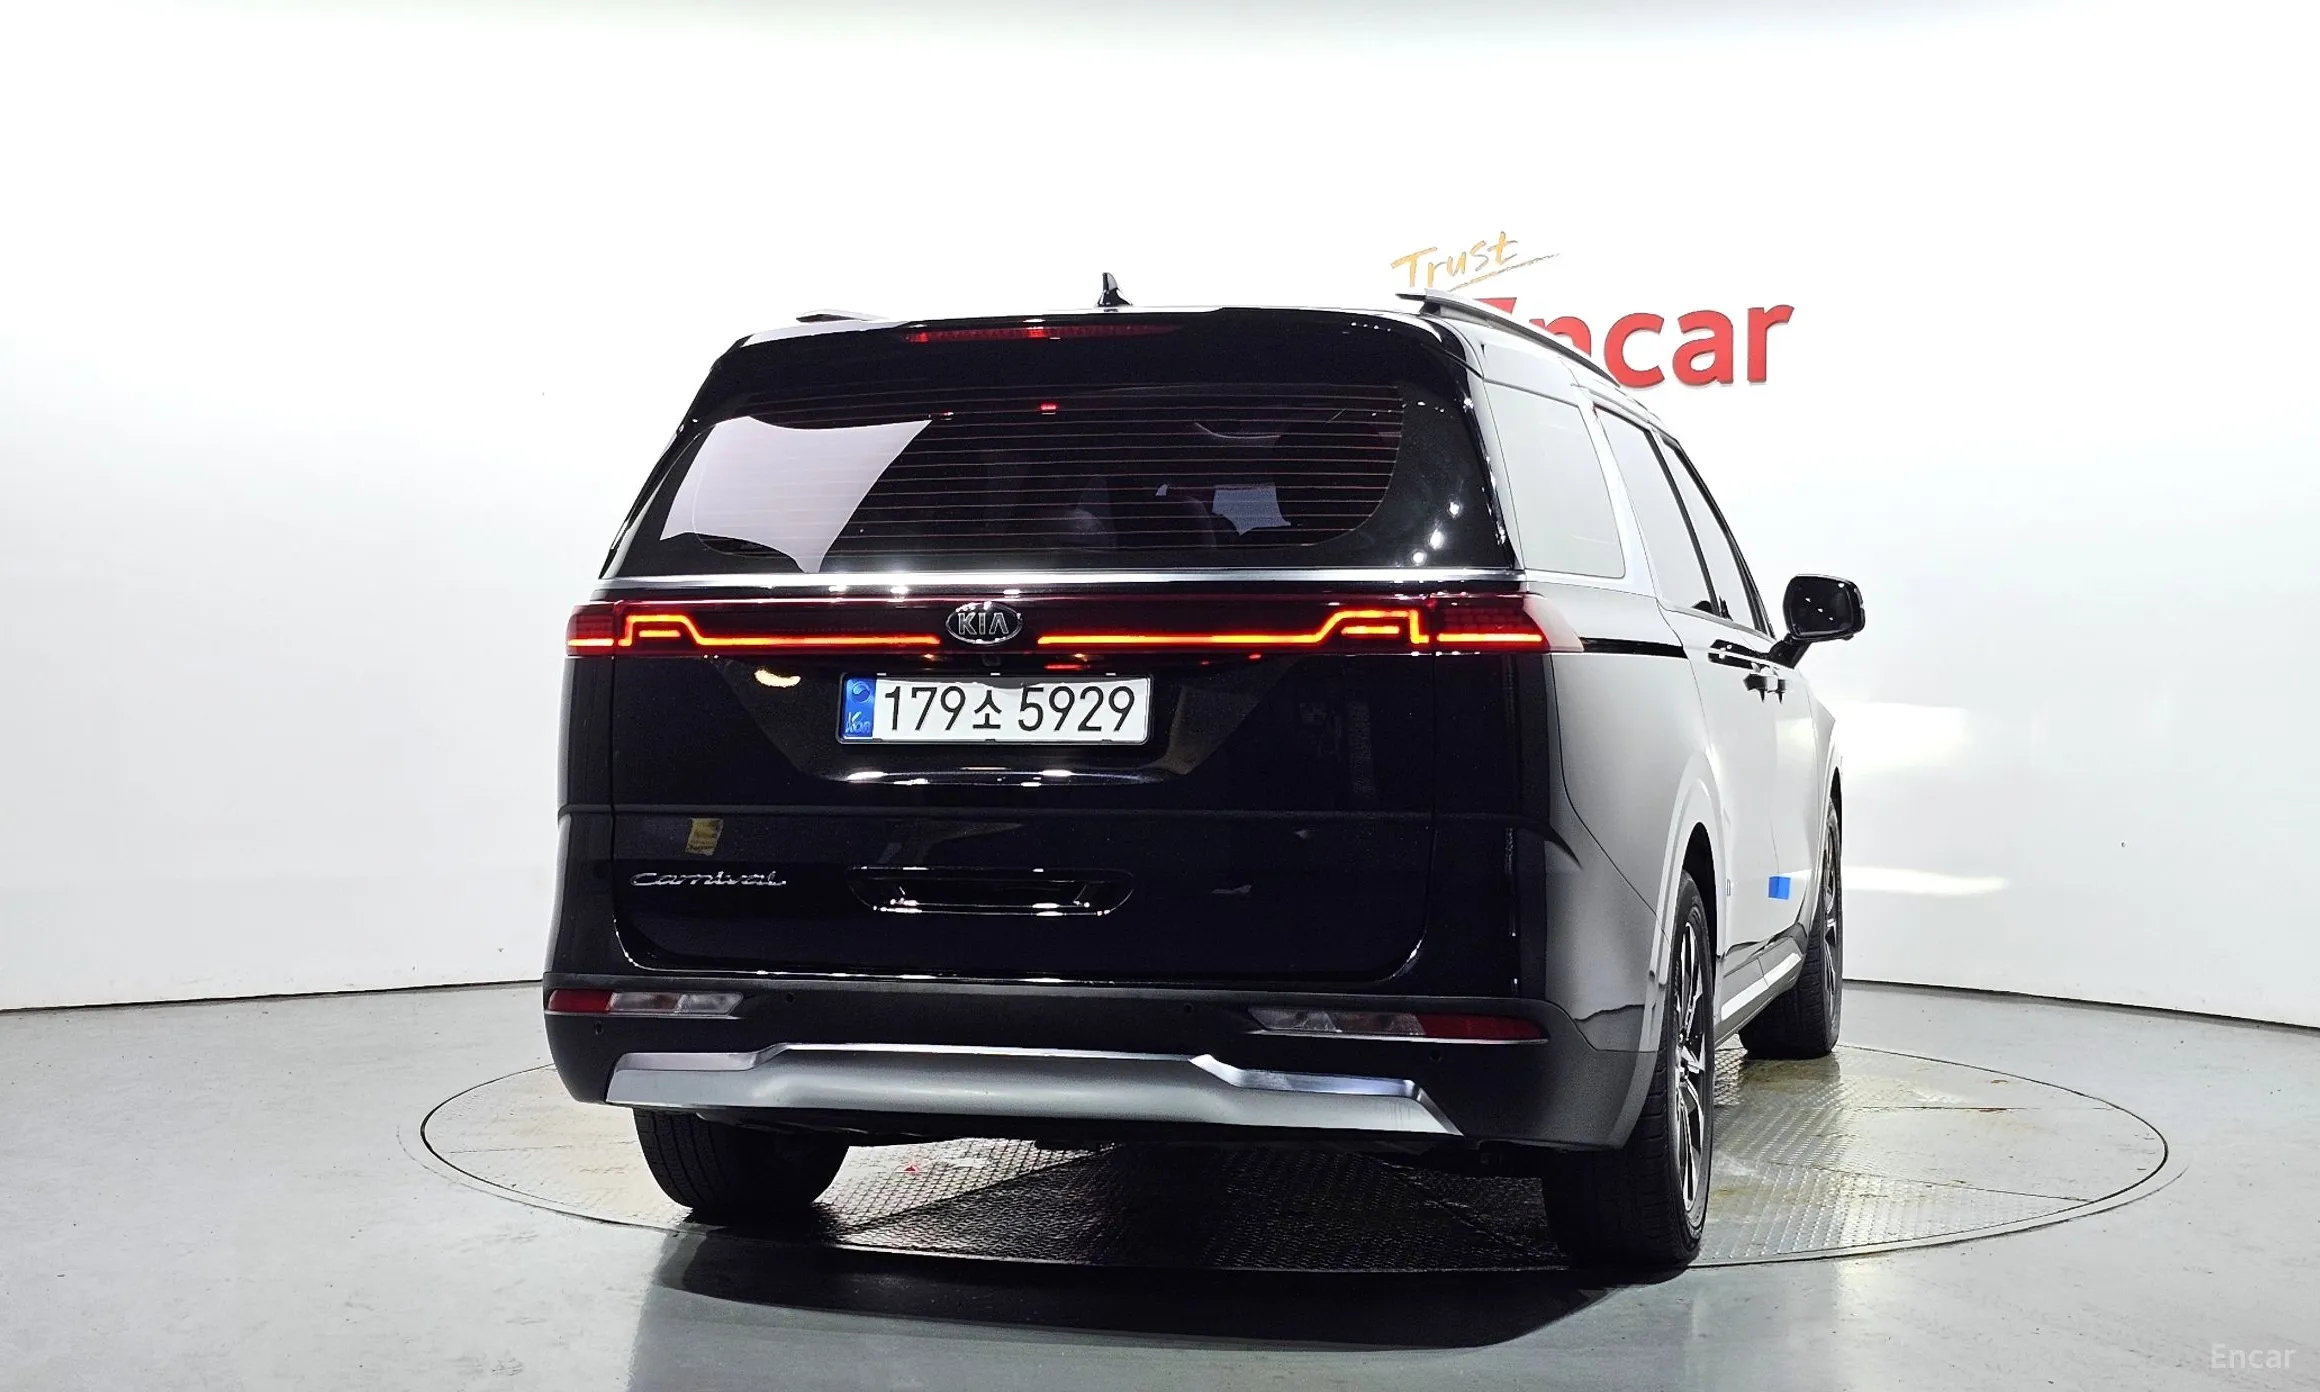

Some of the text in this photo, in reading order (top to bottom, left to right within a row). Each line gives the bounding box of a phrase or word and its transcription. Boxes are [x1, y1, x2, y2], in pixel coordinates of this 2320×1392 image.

[1391, 231, 1518, 288] Trust
[1473, 297, 1794, 389] car
[958, 612, 1009, 635] KIA
[884, 685, 1135, 732] 179소 5929
[629, 871, 787, 887] Carnival
